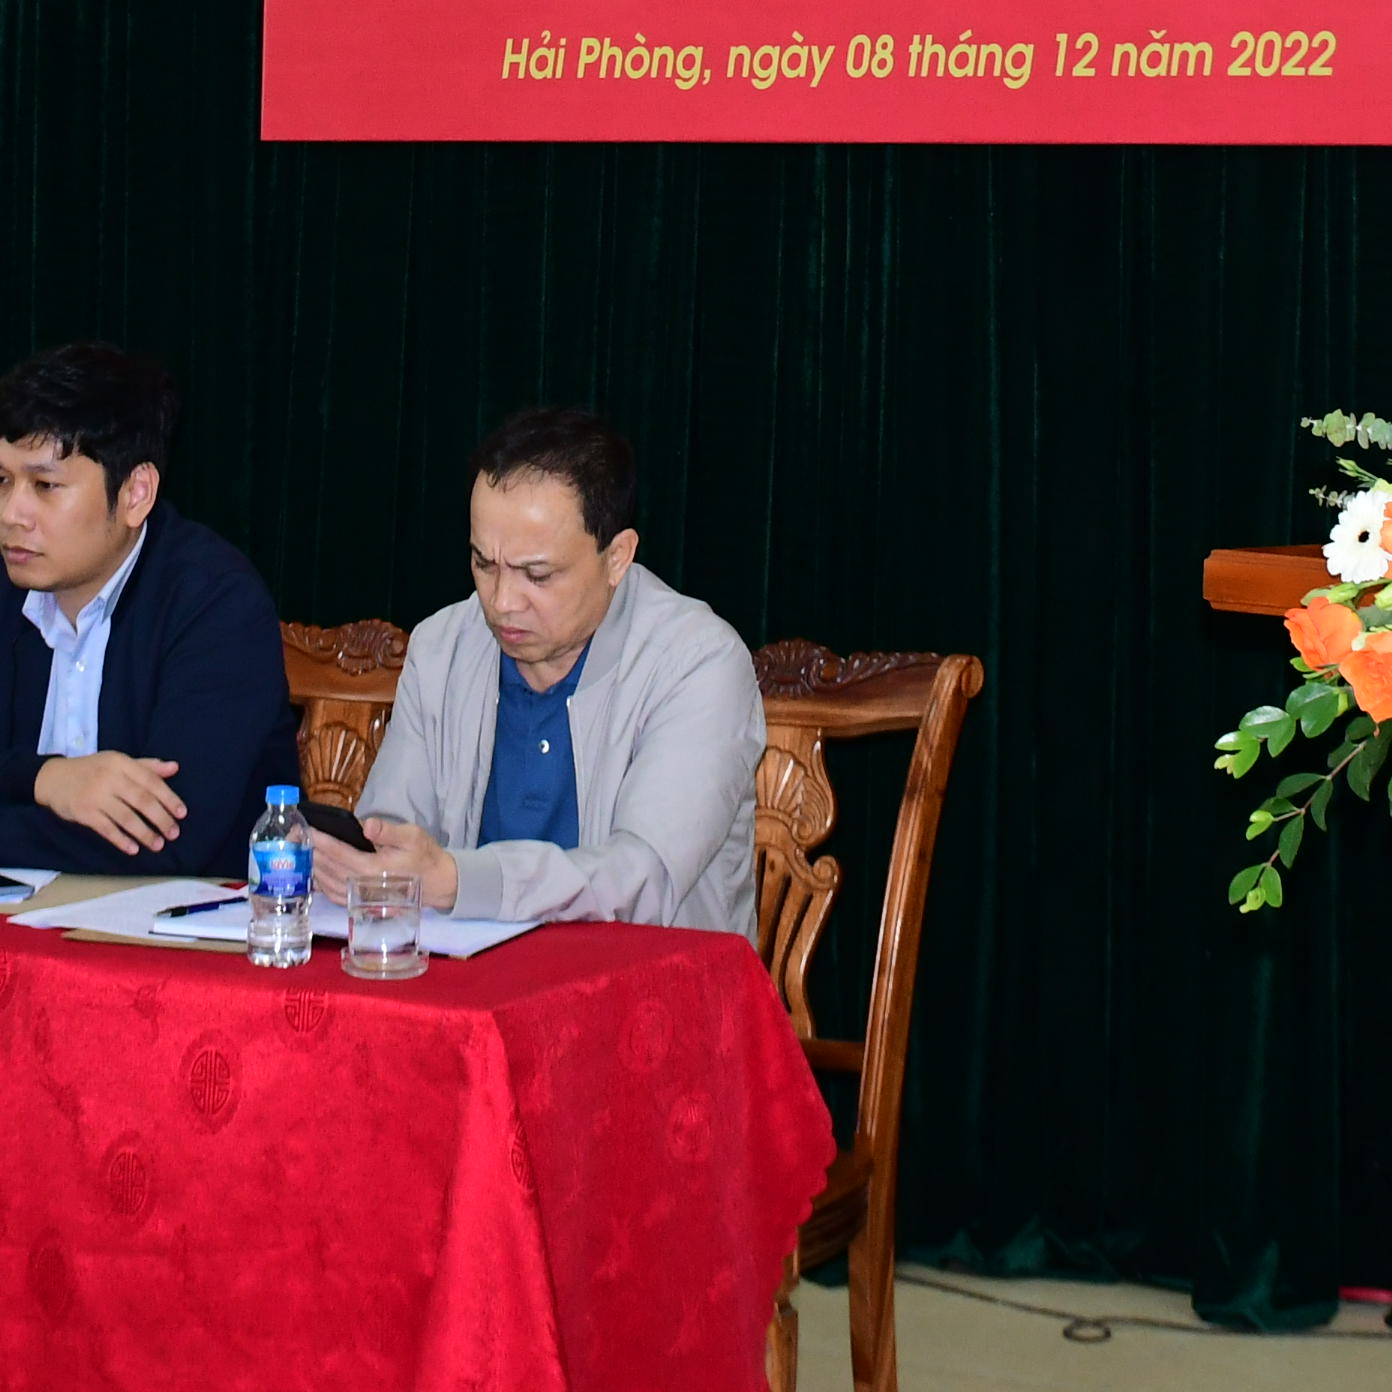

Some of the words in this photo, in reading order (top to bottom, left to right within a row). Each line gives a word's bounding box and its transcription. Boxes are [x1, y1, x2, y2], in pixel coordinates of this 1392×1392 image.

[500, 28, 567, 82] Hải
[574, 31, 714, 88] Phòng,
[724, 29, 838, 92] ngày
[844, 32, 896, 80] 08
[906, 28, 1036, 91] tháng
[1054, 30, 1101, 78] 12
[1108, 28, 1215, 79] năm
[1225, 29, 1339, 79] 2022
